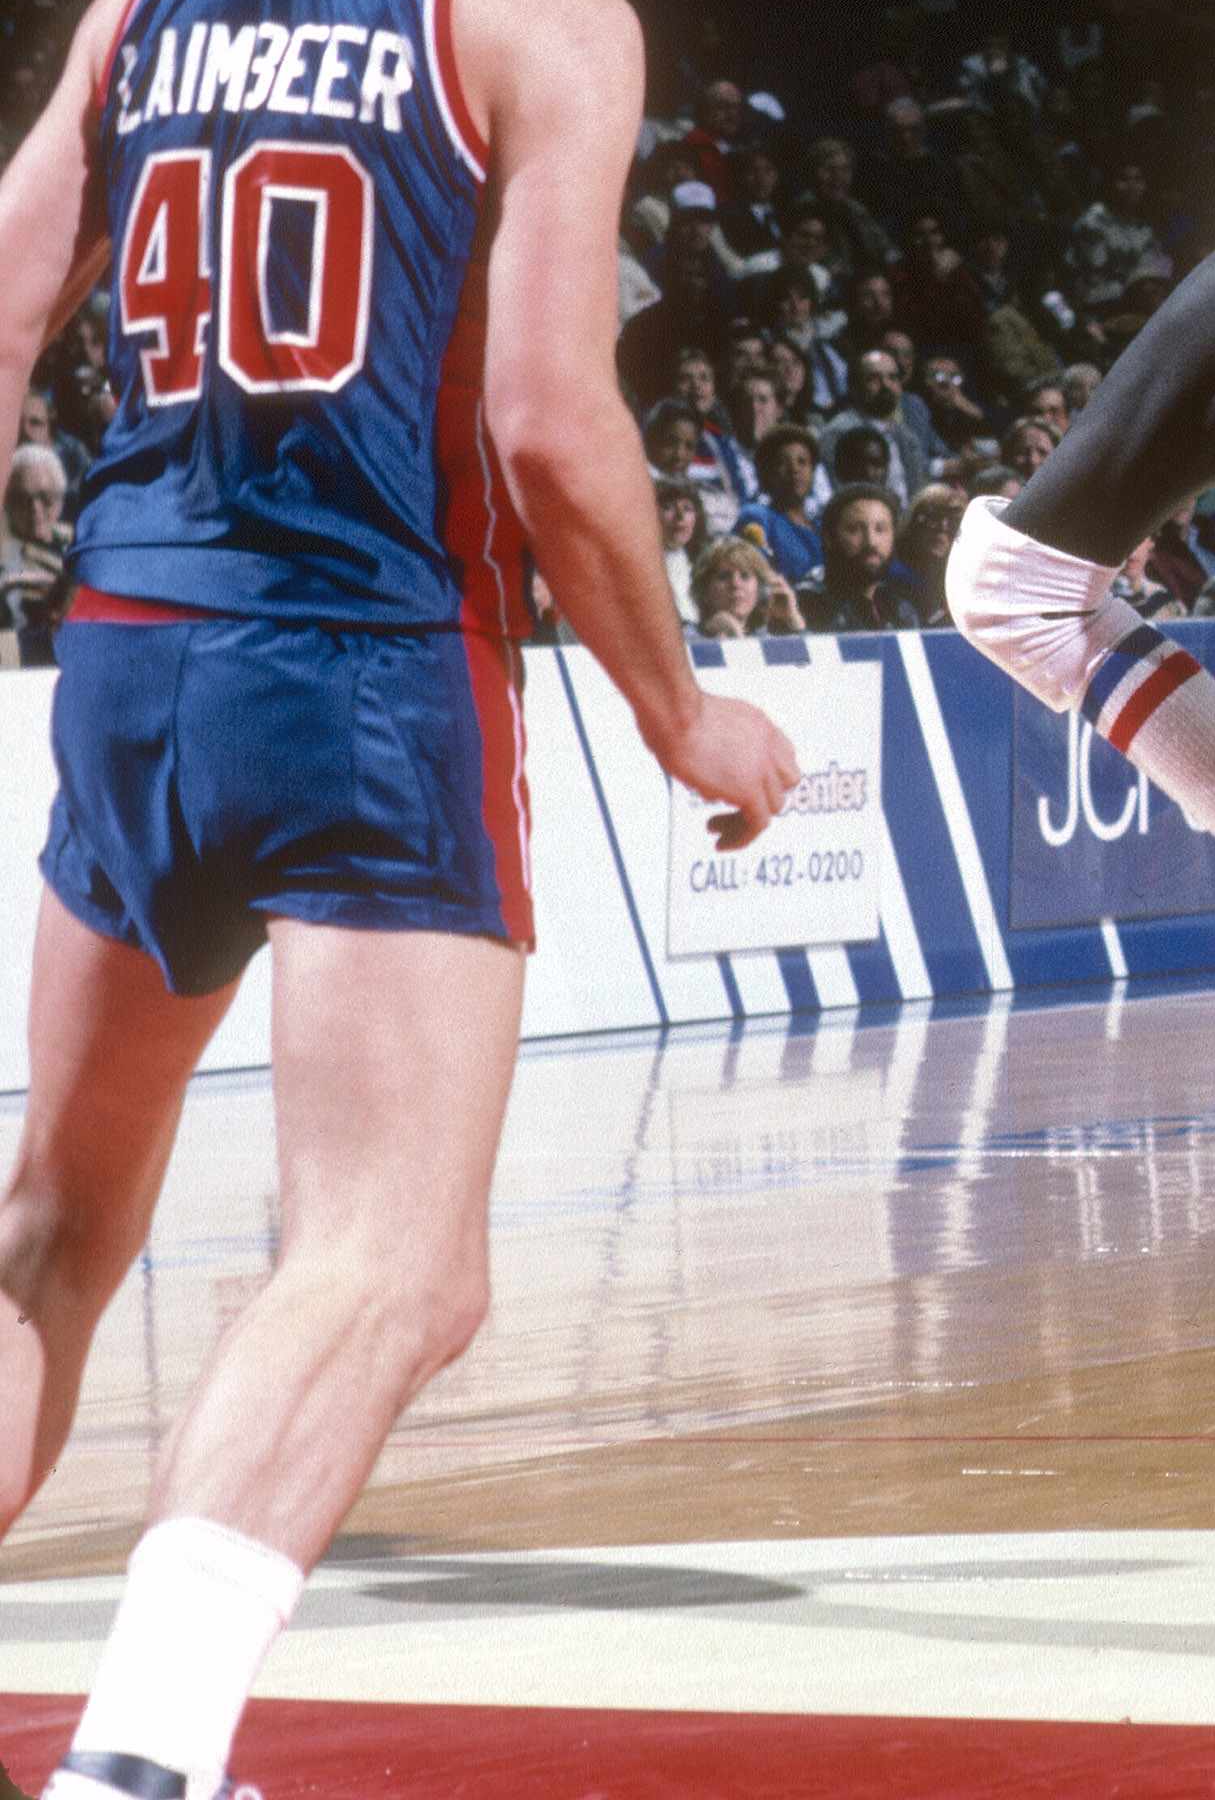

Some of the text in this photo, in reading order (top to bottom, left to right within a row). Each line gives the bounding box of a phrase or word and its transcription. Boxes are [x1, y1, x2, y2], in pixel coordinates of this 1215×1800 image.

[117, 21, 414, 134] LAIMBEER
[120, 140, 375, 408] 40
[778, 761, 867, 816] enter
